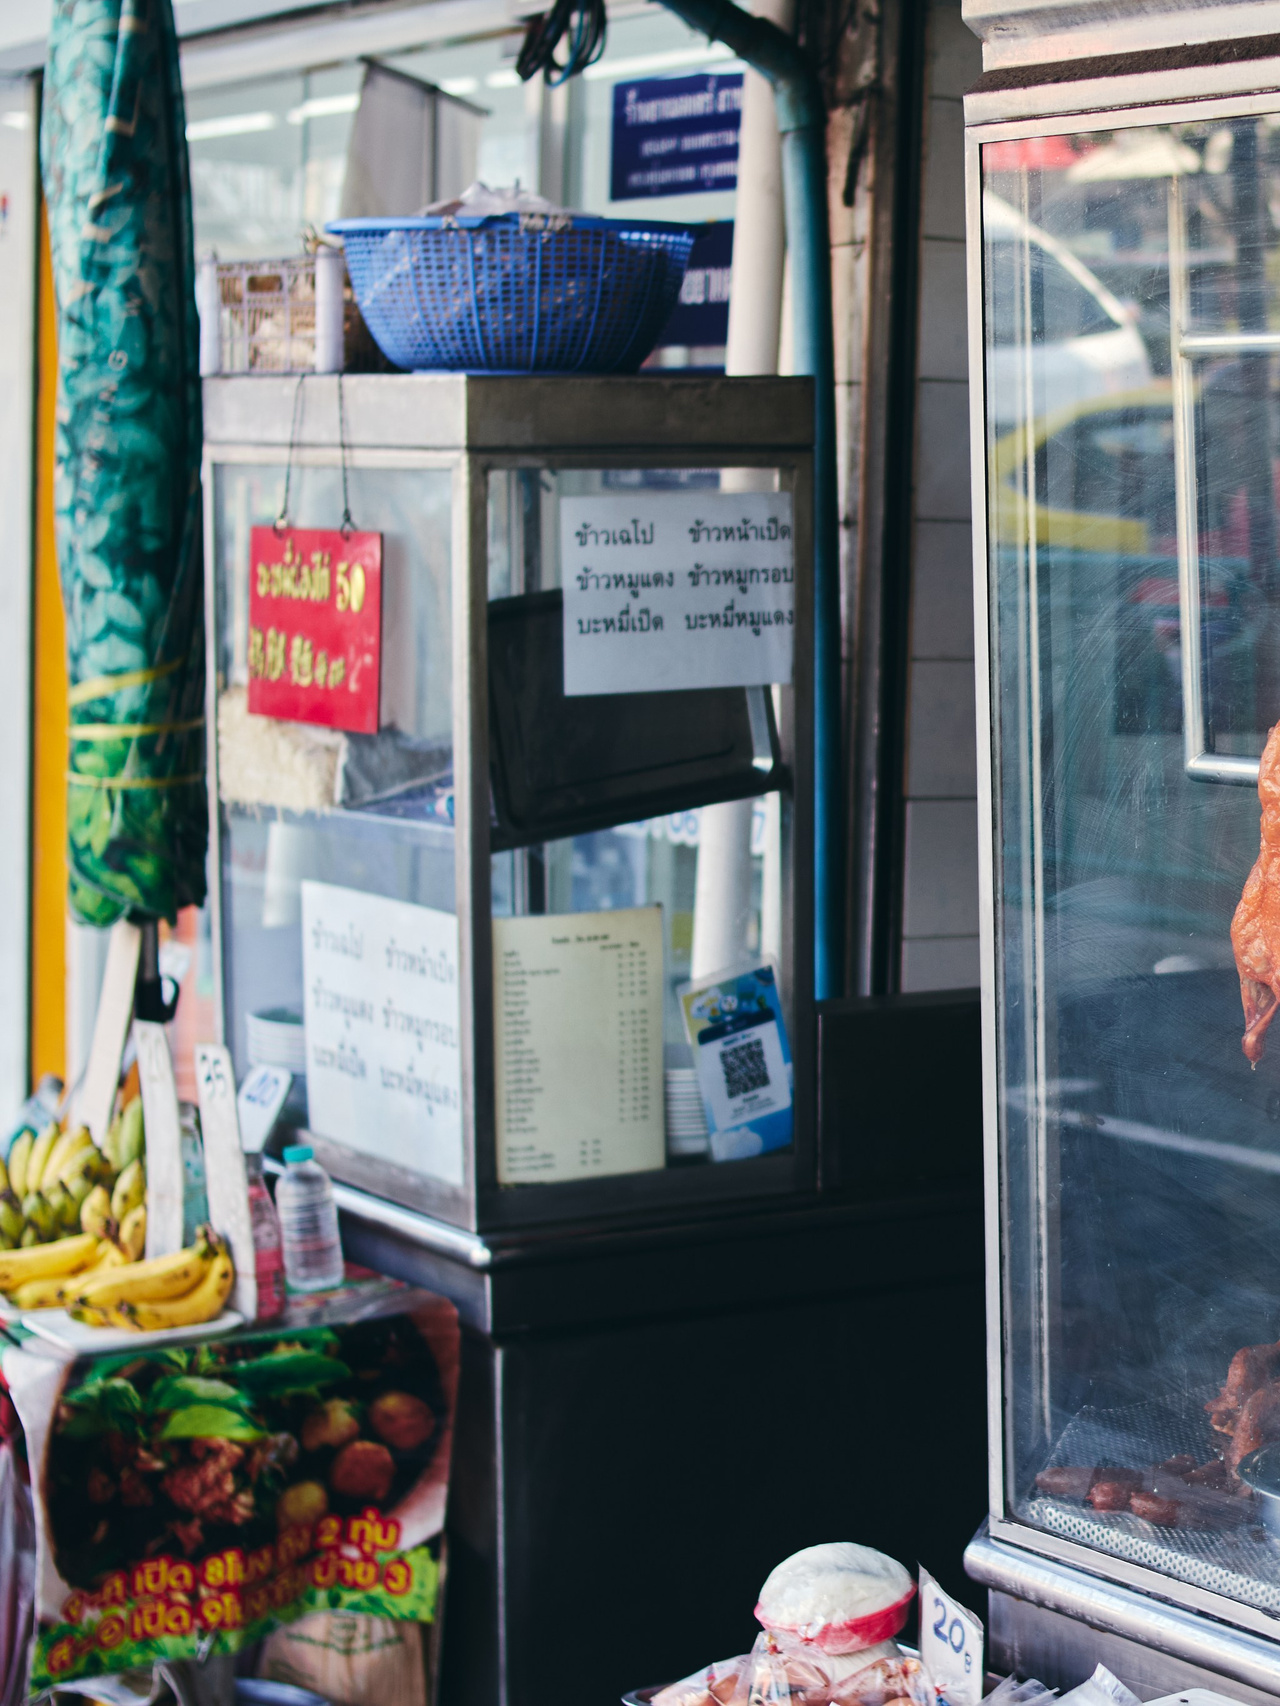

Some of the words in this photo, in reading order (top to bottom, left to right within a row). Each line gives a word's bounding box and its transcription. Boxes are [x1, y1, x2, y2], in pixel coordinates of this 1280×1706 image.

[575, 519, 654, 547] ข้าวเฉโป
[688, 517, 792, 544] ข้าวหน้าเป็ด
[576, 566, 675, 599] ข้าวหมูแดง
[688, 563, 794, 595] ข้าวหมูกรอบ
[577, 602, 664, 635] บะหมี่เป็ด
[685, 599, 794, 637] บะหมี่หมูแดง
[133, 1556, 195, 1597] เปิด
[317, 1515, 342, 1547] 2
[130, 1598, 193, 1640] เปิด
[384, 1559, 412, 1595] 3
[933, 1597, 965, 1654] 20
